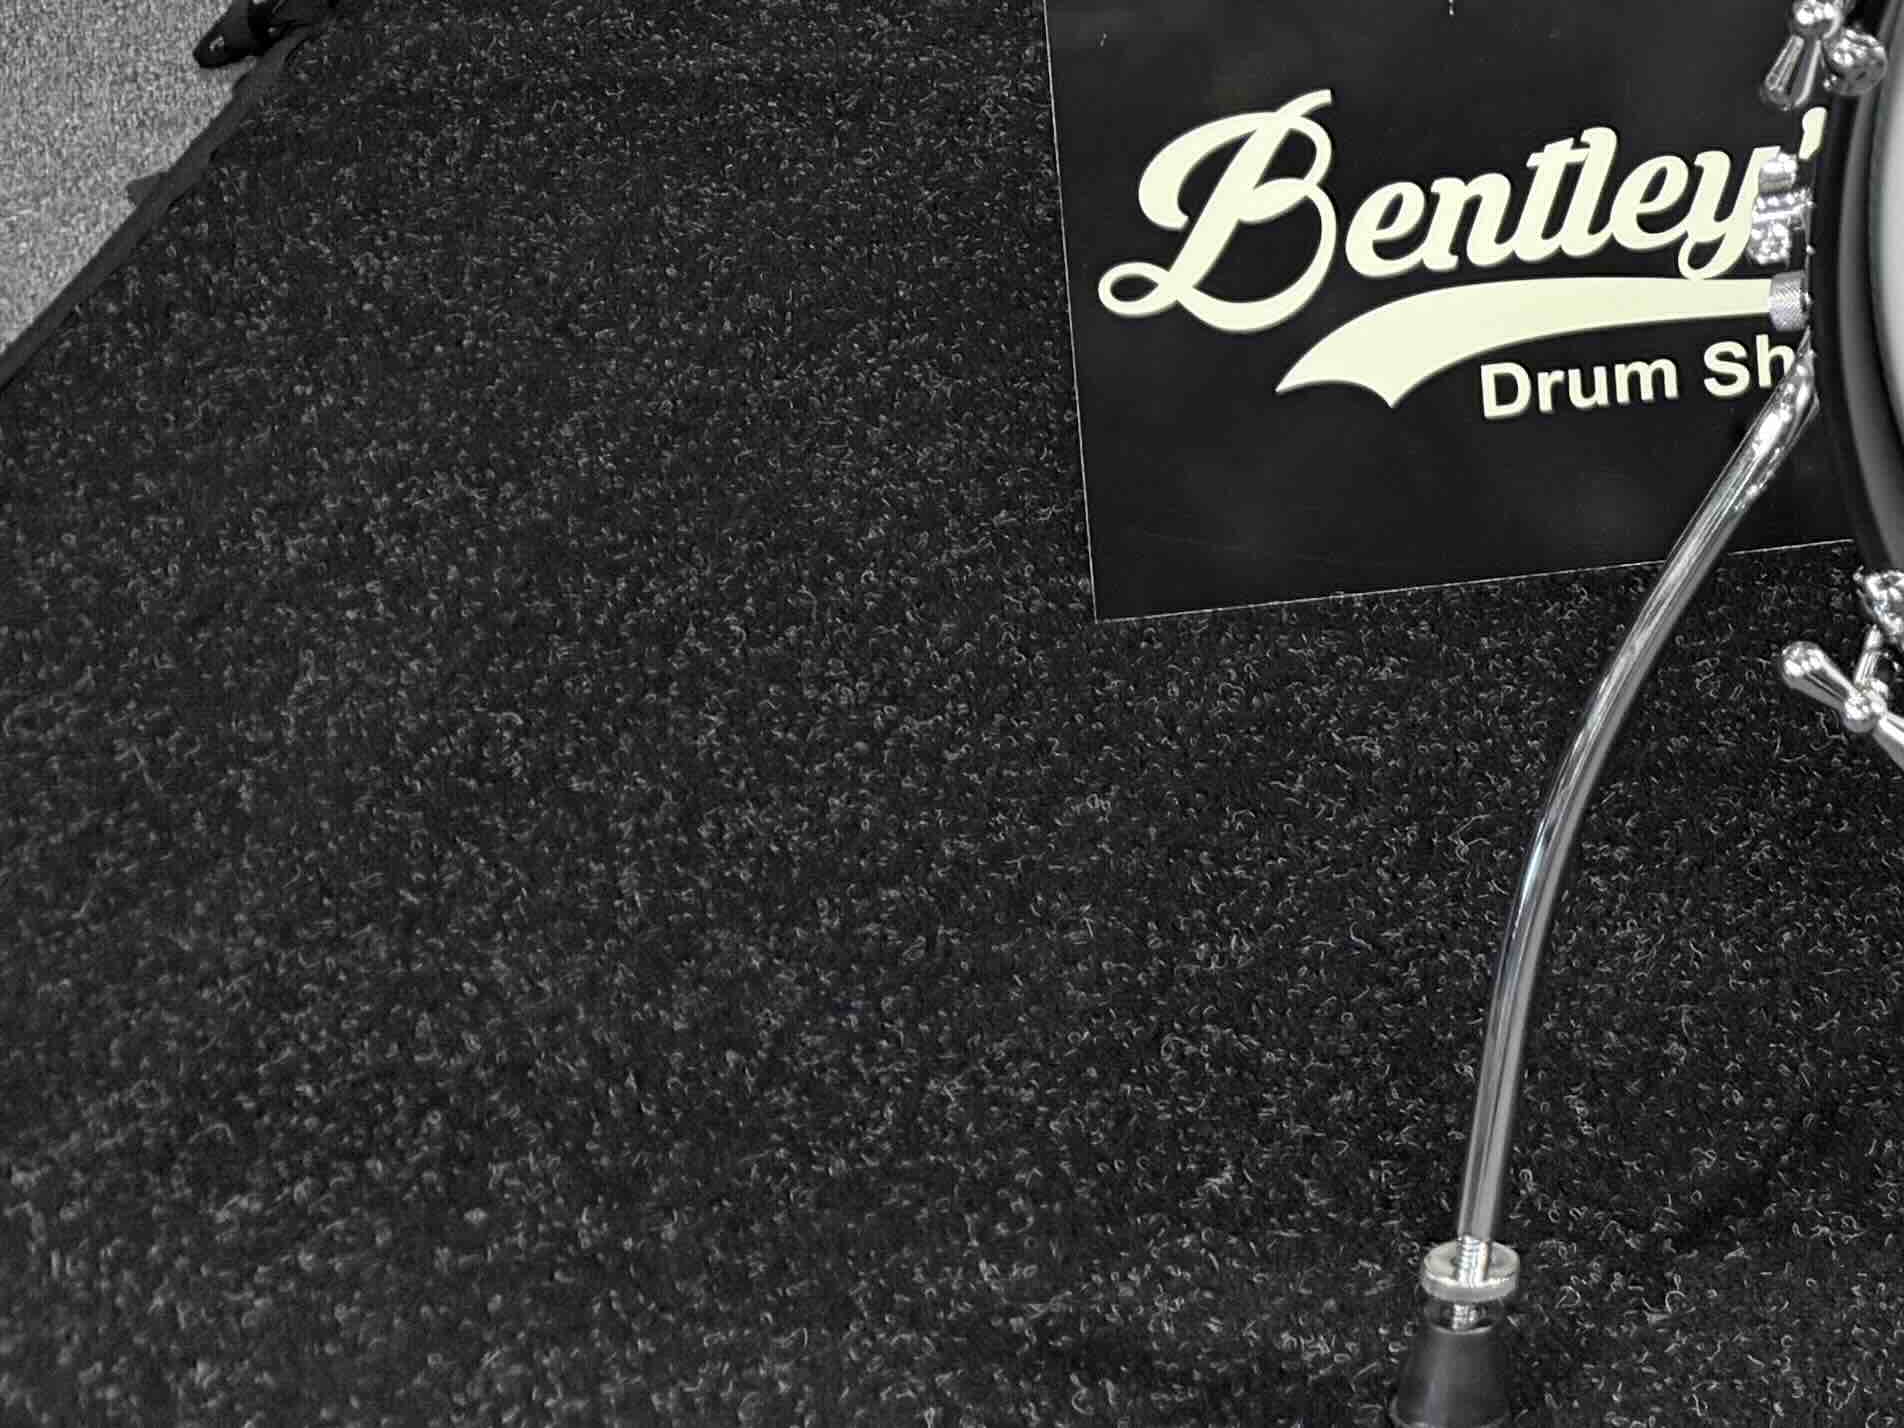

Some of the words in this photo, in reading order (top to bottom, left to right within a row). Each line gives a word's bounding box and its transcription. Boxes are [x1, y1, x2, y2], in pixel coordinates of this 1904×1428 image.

[1097, 88, 1826, 334] Bentley'
[1479, 349, 1679, 420] Drum
[1702, 334, 1798, 400] Sh
